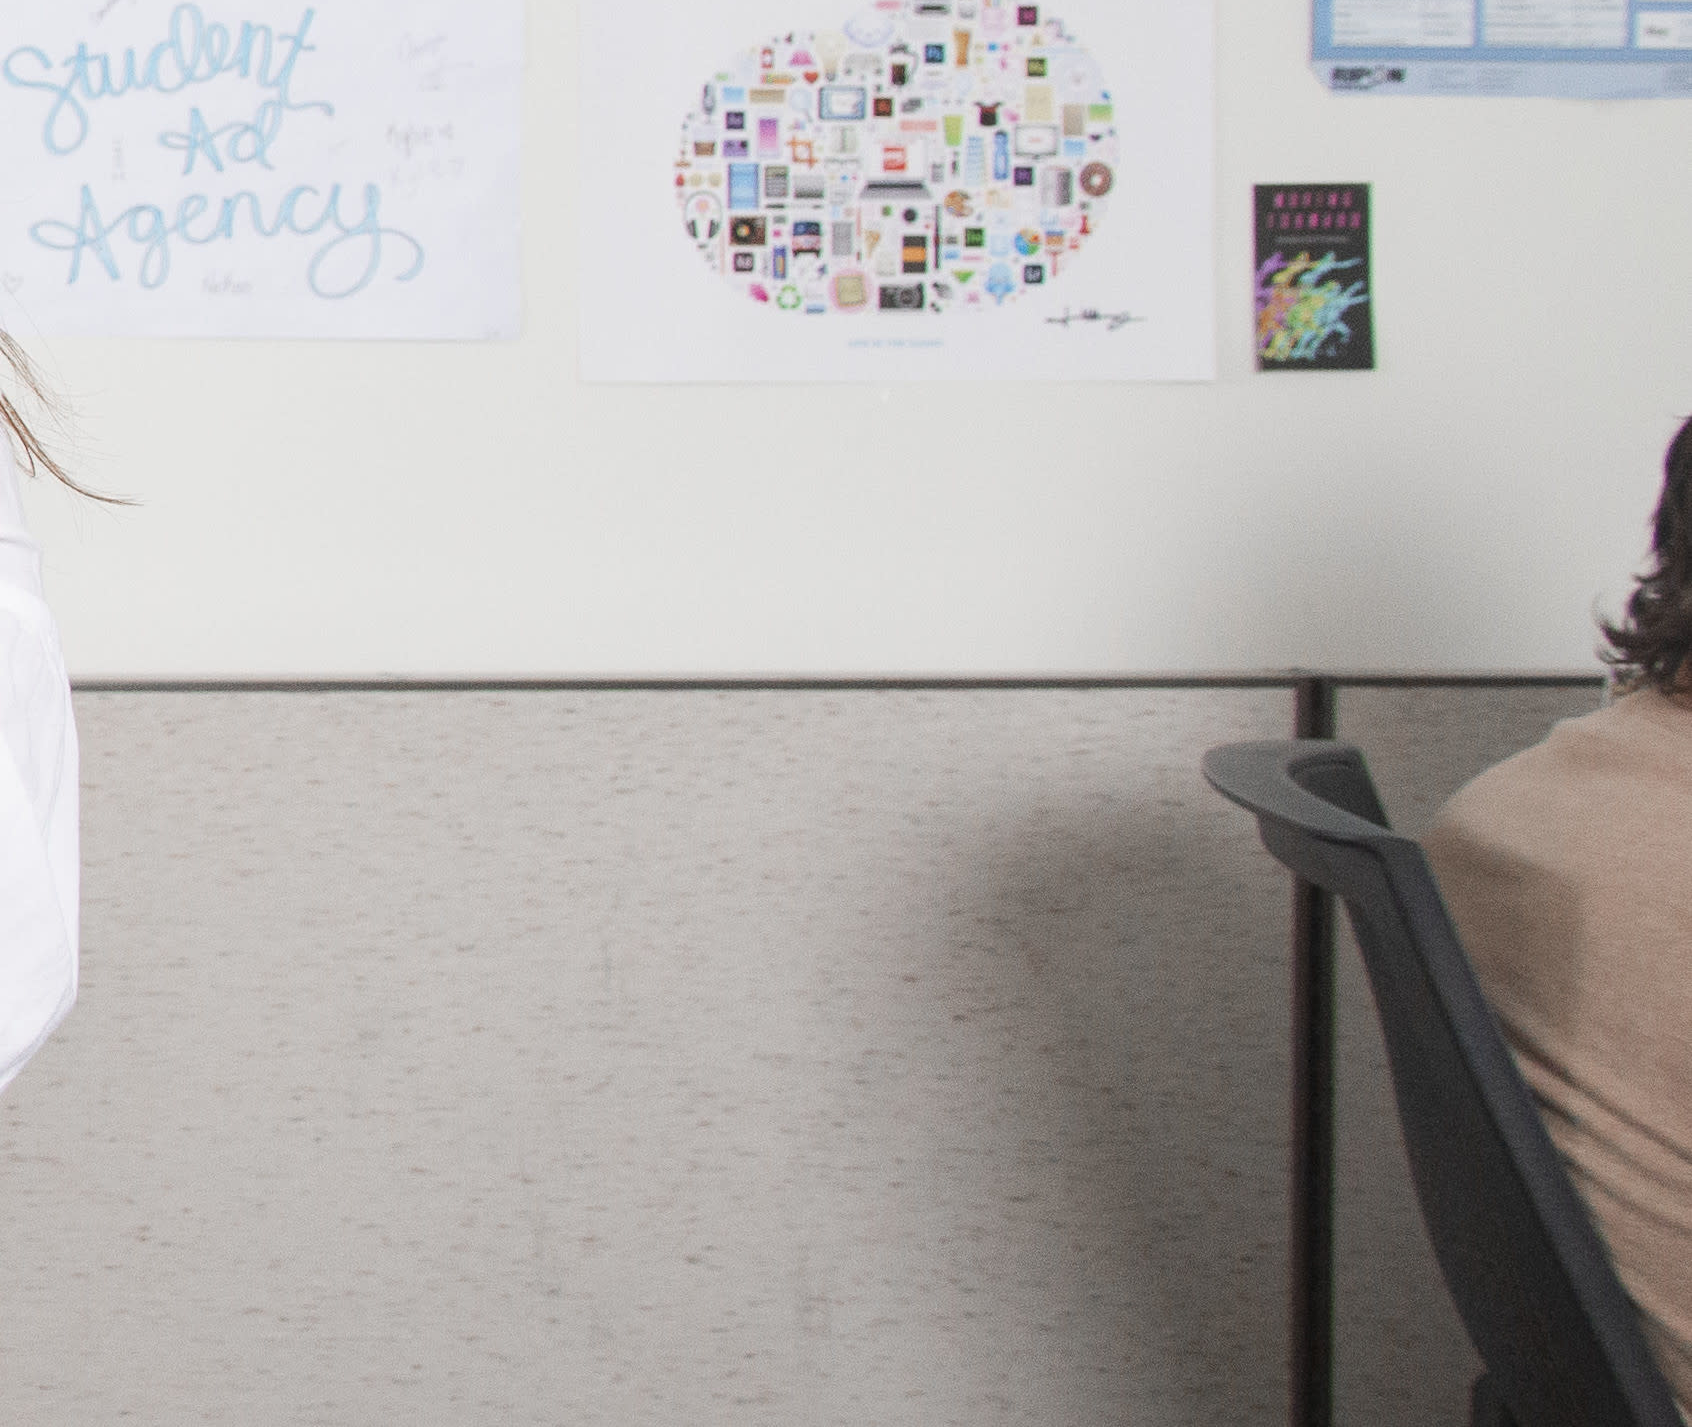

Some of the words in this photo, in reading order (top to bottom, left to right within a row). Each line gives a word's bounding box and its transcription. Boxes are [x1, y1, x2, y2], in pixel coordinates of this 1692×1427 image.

[3, 2, 334, 155] Student
[158, 99, 276, 174] Ad
[30, 183, 425, 299] Agency
